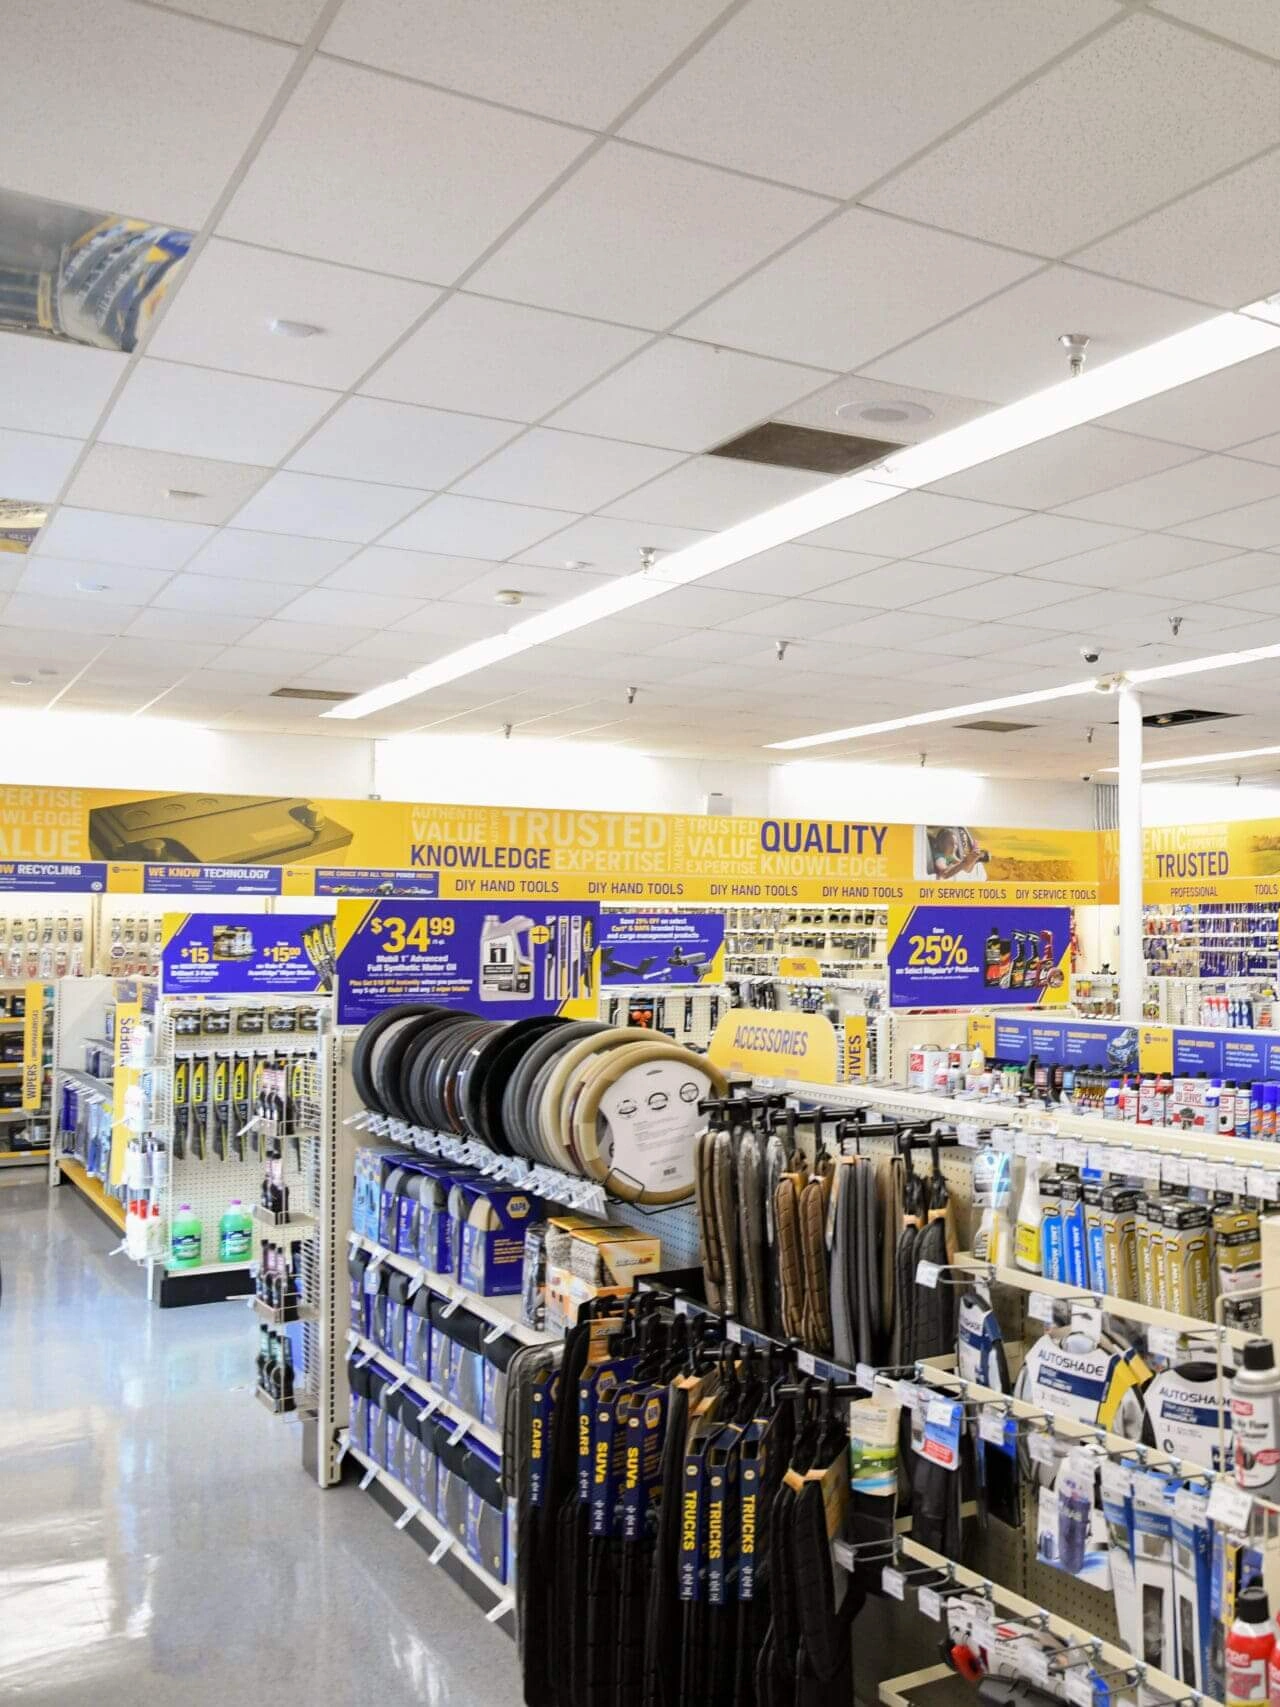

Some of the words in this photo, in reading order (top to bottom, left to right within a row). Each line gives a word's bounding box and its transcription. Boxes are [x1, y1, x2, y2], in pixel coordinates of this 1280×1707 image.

[0, 809, 82, 826] WLEDGE
[687, 818, 759, 834] TRUSTED
[412, 820, 487, 842] VALUE
[502, 811, 667, 849] TRUSTED
[760, 820, 888, 855] QUALITY
[410, 844, 551, 869] KNOWLEDGE
[687, 836, 758, 859] VALUE
[18, 865, 81, 875] RECYCLING
[555, 849, 666, 872] EXPERTISE
[687, 860, 757, 875] EXPERTISE
[760, 856, 888, 878] KNOWLEDGE
[1156, 851, 1229, 878] TRUSTED
[148, 867, 166, 877] WE
[169, 868, 199, 878] KNOW
[204, 868, 270, 879] TECHNOLOGY
[455, 879, 475, 892] DIY
[481, 880, 515, 892] HAND
[520, 881, 559, 893] TOOLS
[588, 882, 606, 894] DIY
[611, 882, 643, 894] HAND
[648, 883, 684, 895] TOOLS
[711, 884, 728, 895] DIY
[731, 884, 761, 896] HAND
[765, 885, 798, 896] TOOLS
[822, 886, 838, 897] DIY
[841, 886, 868, 898] HAND
[872, 887, 903, 898] TOOLS
[919, 888, 934, 898] DIY
[938, 888, 975, 899] SERVICE
[978, 889, 1006, 899] TOOLS
[1015, 889, 1030, 899] DIY
[1032, 889, 1067, 900] SERVICE
[1070, 890, 1097, 899] TOOLS
[1170, 887, 1218, 897] PROFESSIONAL
[1255, 884, 1278, 895] TOOLS
[181, 947, 209, 964] $15
[908, 934, 968, 966] 25%
[384, 964, 420, 973] Synthetic
[733, 1025, 809, 1057] ACCESSORIES
[26, 1064, 38, 1099] WIPERS
[1038, 1350, 1104, 1376] AUTOSHADE
[532, 1419, 542, 1459] CARS
[579, 1415, 589, 1456] CARS
[595, 1442, 609, 1484] SUVs
[626, 1447, 639, 1488] SUVs
[683, 1491, 697, 1551] TRUCKS
[709, 1500, 722, 1560] TRUCKS
[742, 1494, 756, 1554] TRUCKS
[1226, 1649, 1250, 1668] CRC
